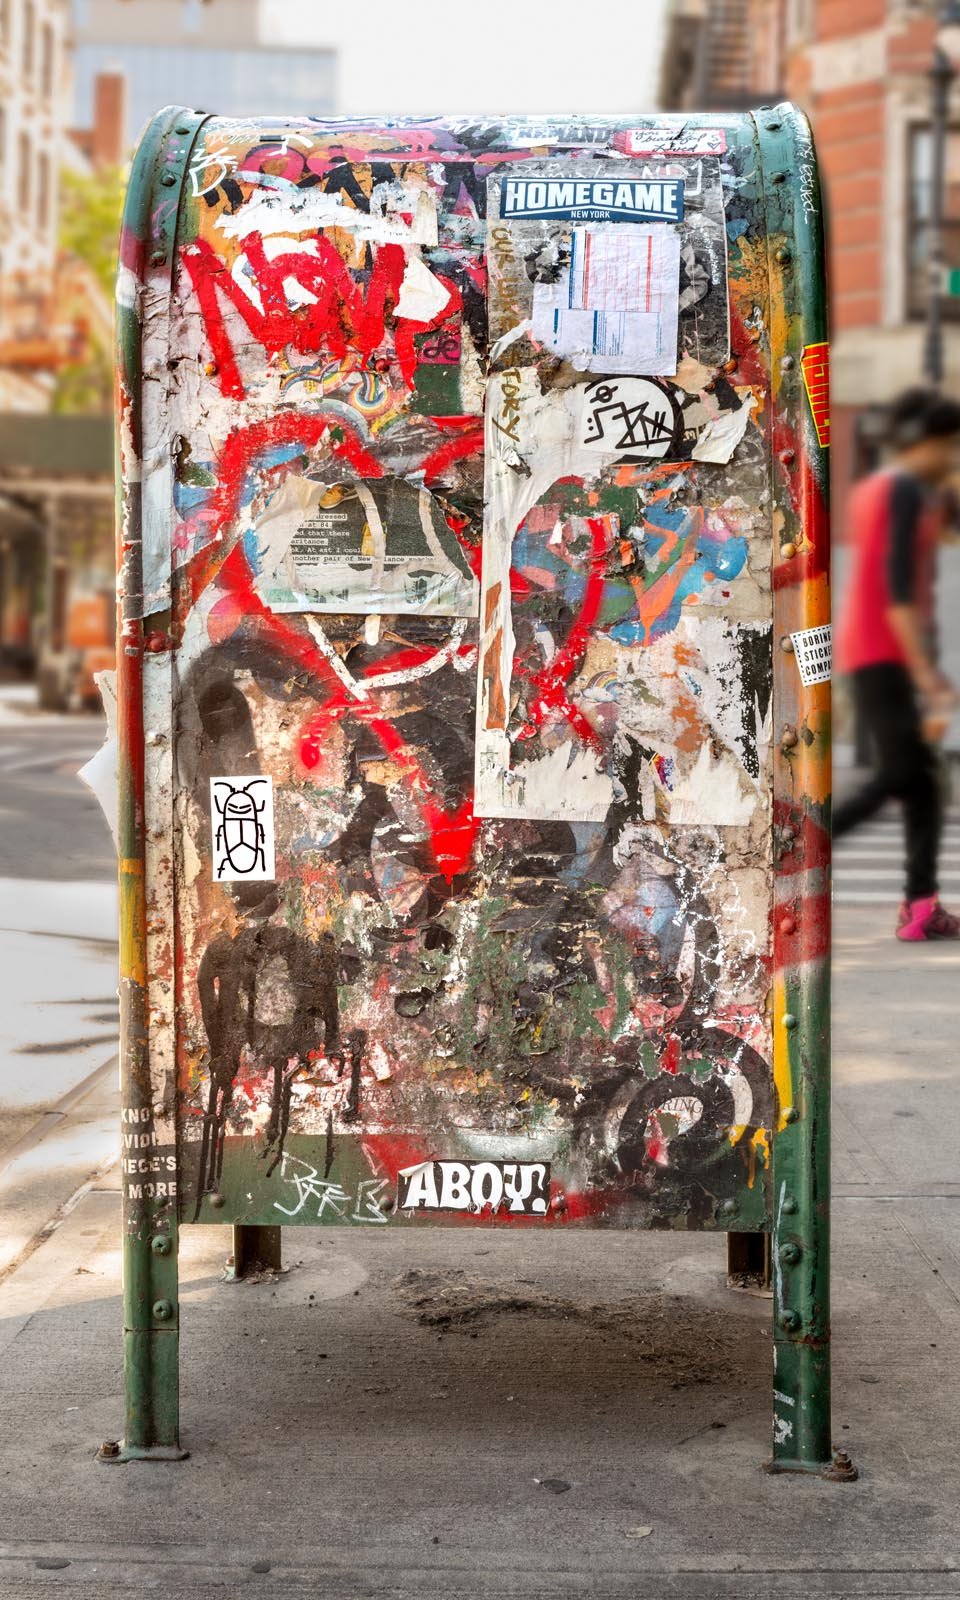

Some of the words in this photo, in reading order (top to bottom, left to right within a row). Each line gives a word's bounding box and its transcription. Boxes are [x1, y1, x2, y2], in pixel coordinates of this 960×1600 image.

[570, 210, 588, 219] NEW
[590, 210, 611, 219] YORK
[492, 227, 515, 270] OUR
